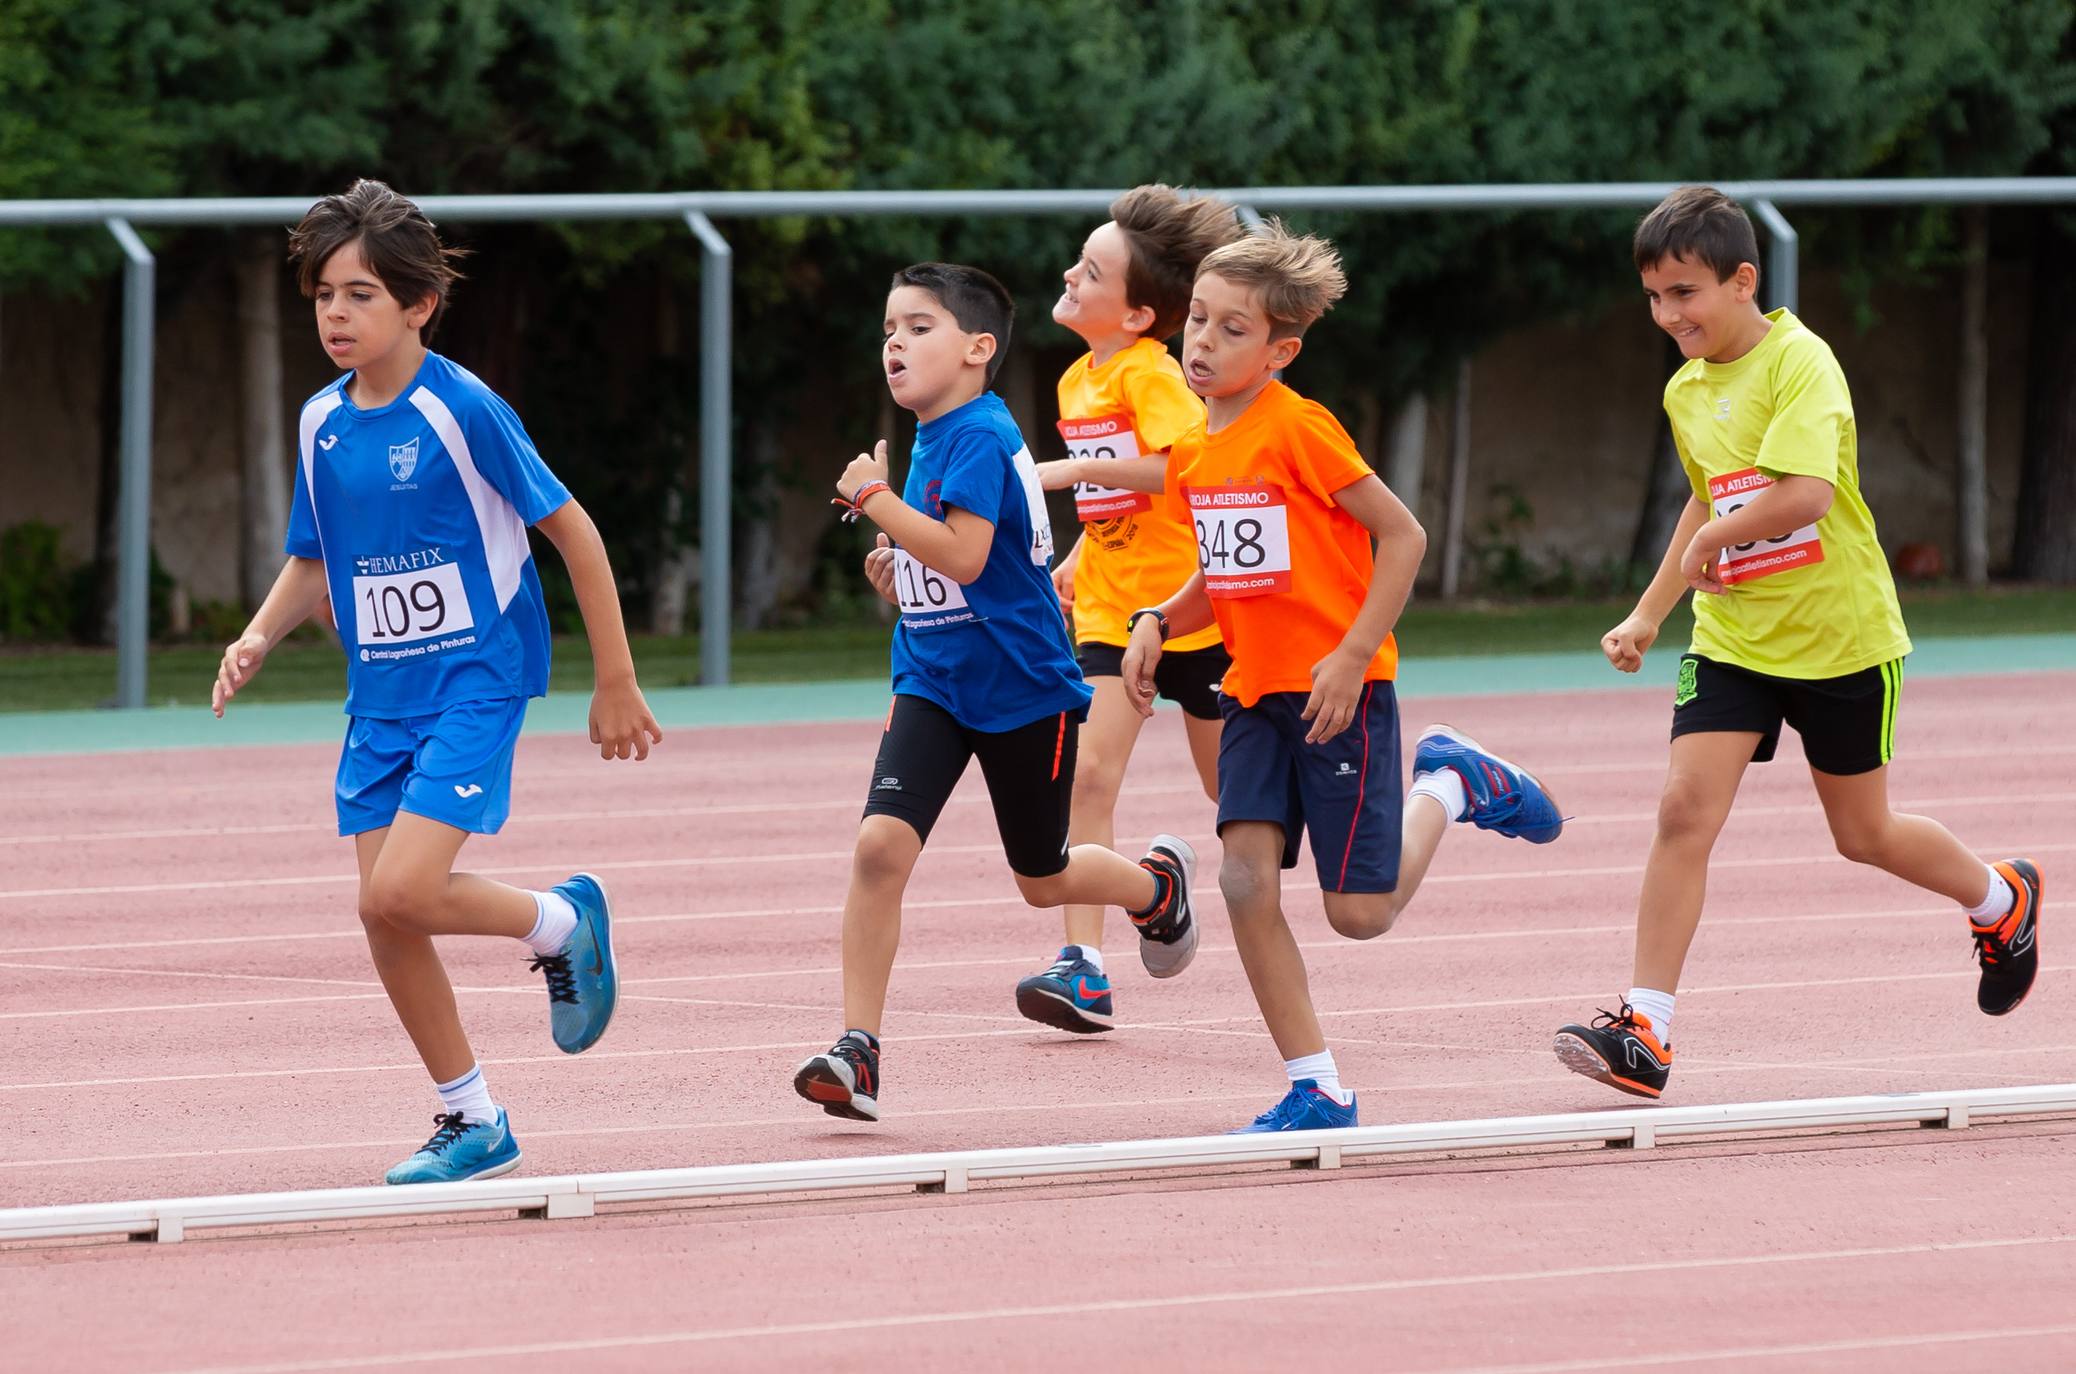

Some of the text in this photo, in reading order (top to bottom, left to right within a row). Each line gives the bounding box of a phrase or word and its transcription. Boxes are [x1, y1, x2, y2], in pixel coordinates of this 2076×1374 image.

[1213, 491, 1269, 506] ATLETISMO
[1196, 518, 1266, 568] 348
[369, 547, 444, 574] HEMAFIX
[366, 580, 446, 638] 109
[427, 643, 440, 653] de
[440, 635, 476, 650] Pinturas
